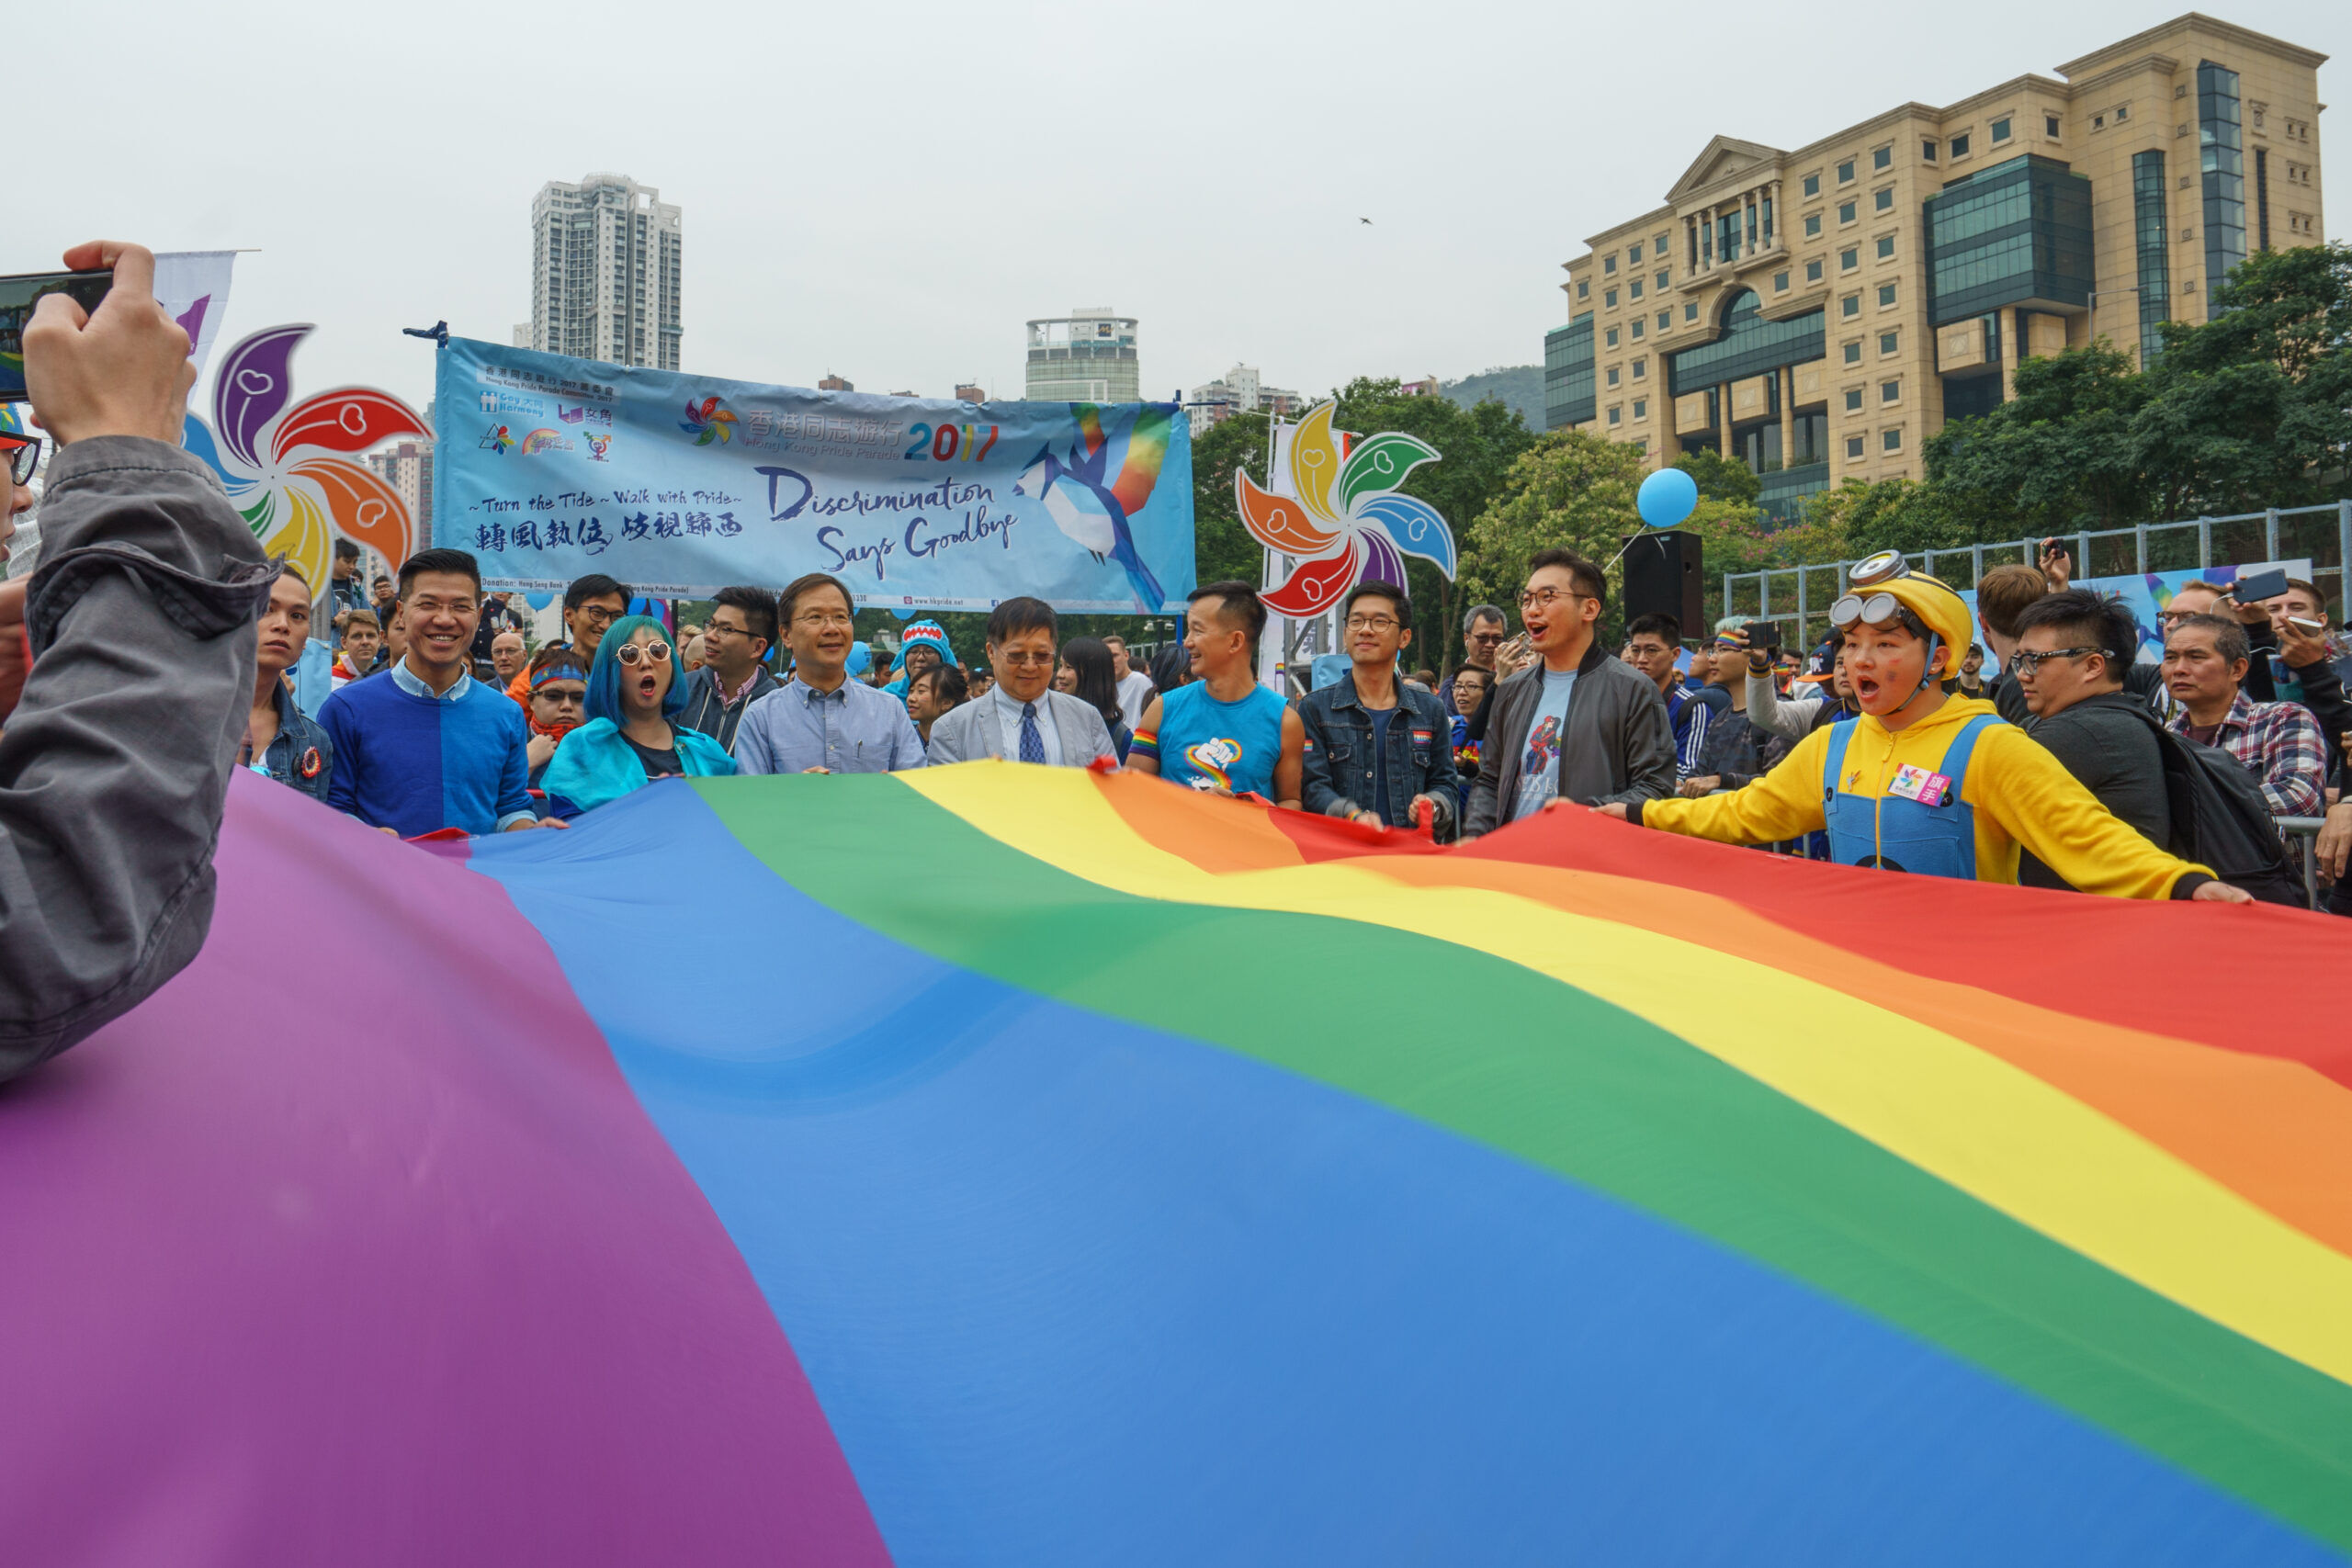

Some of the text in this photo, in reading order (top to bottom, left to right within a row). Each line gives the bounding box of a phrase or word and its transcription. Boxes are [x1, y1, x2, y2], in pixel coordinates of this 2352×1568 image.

[485, 375, 613, 403] Hong Kong Pride Parade Committee 2017
[560, 379, 577, 389] 2017
[500, 401, 544, 418] Harmony
[743, 435, 900, 461] Hong Kong Pride Parade
[747, 409, 999, 462] 香港同志遊行 2017
[482, 497, 521, 513] Turn
[528, 494, 555, 511] the
[559, 492, 595, 508] Tide
[614, 489, 650, 505] Walk
[657, 491, 687, 504] with
[753, 466, 995, 522] Discrimination
[817, 505, 1018, 581] Says Goodbye
[481, 578, 516, 588] Donation:
